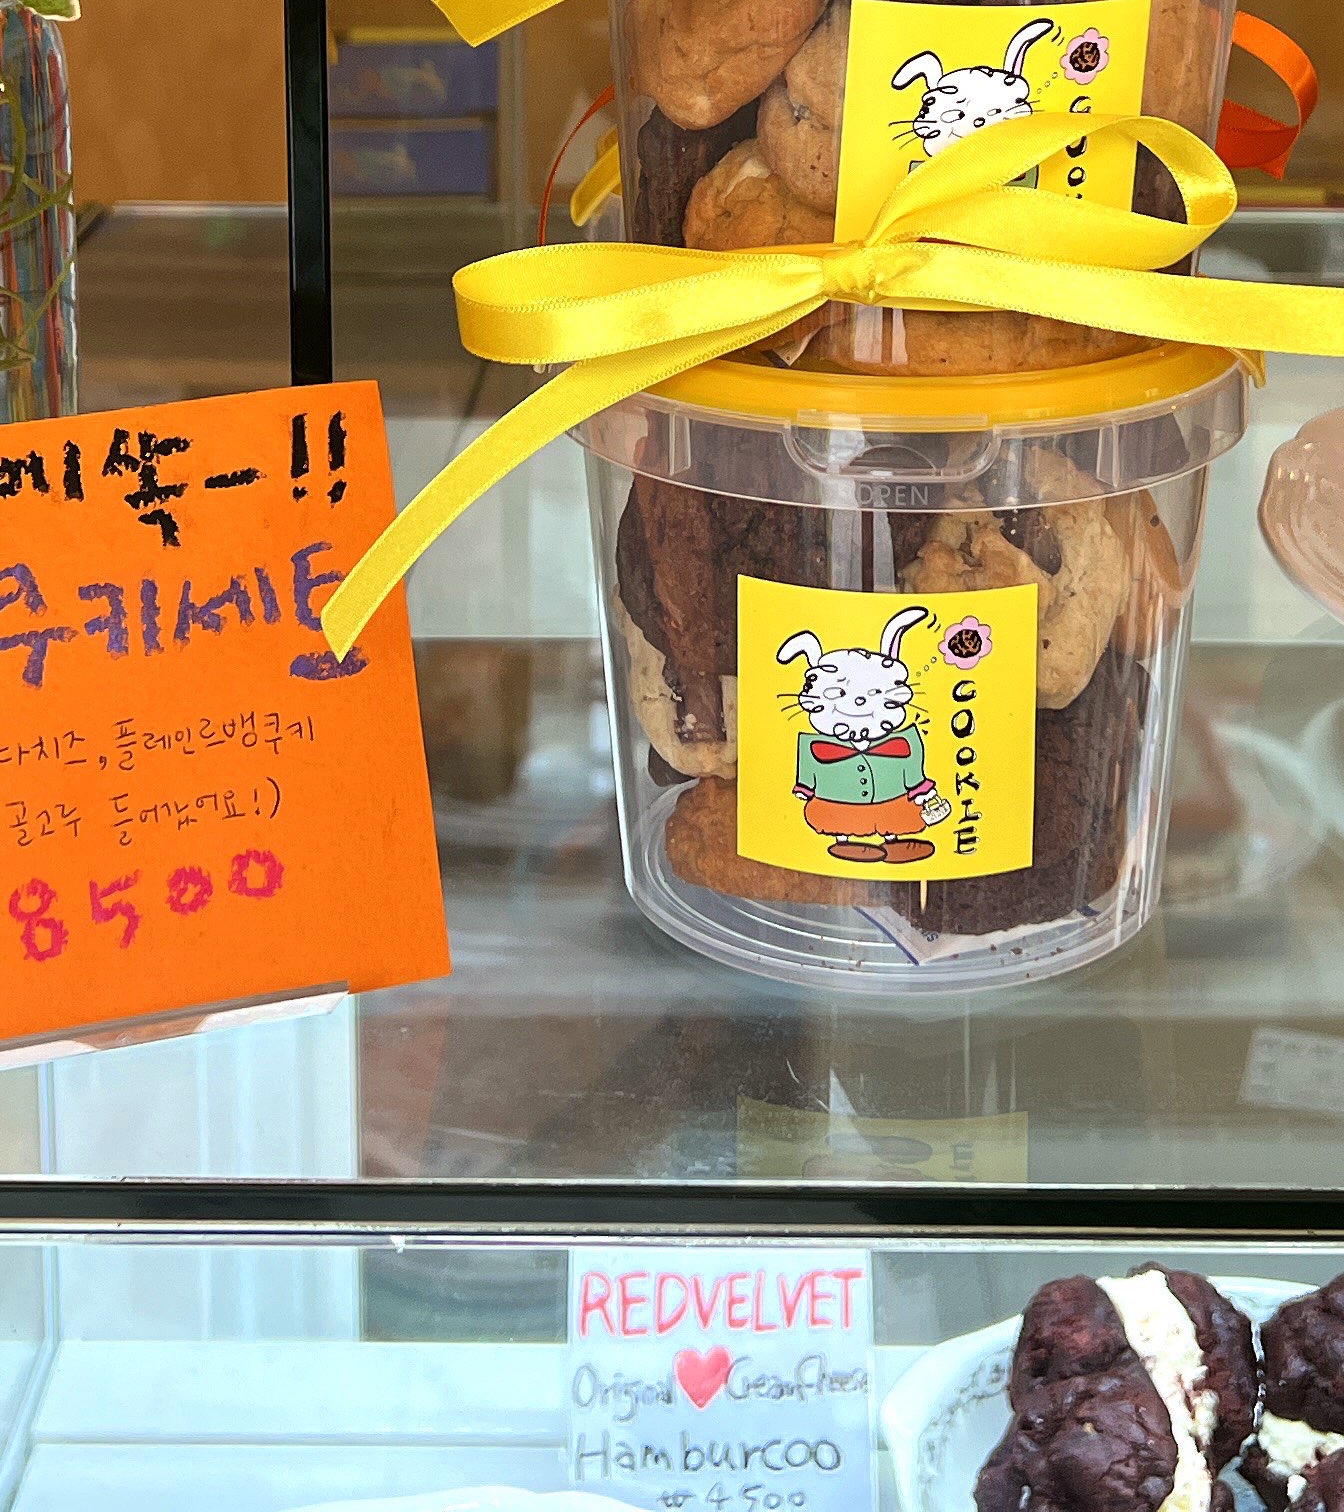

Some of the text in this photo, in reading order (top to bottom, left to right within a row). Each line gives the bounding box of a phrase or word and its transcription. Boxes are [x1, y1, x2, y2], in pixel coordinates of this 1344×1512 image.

[856, 482, 929, 508] OPEN
[950, 679, 983, 856] COOKIE
[5, 799, 84, 847] 골고루
[578, 1268, 864, 1339] REDVELVET
[574, 1430, 843, 1481] Hamburcoo
